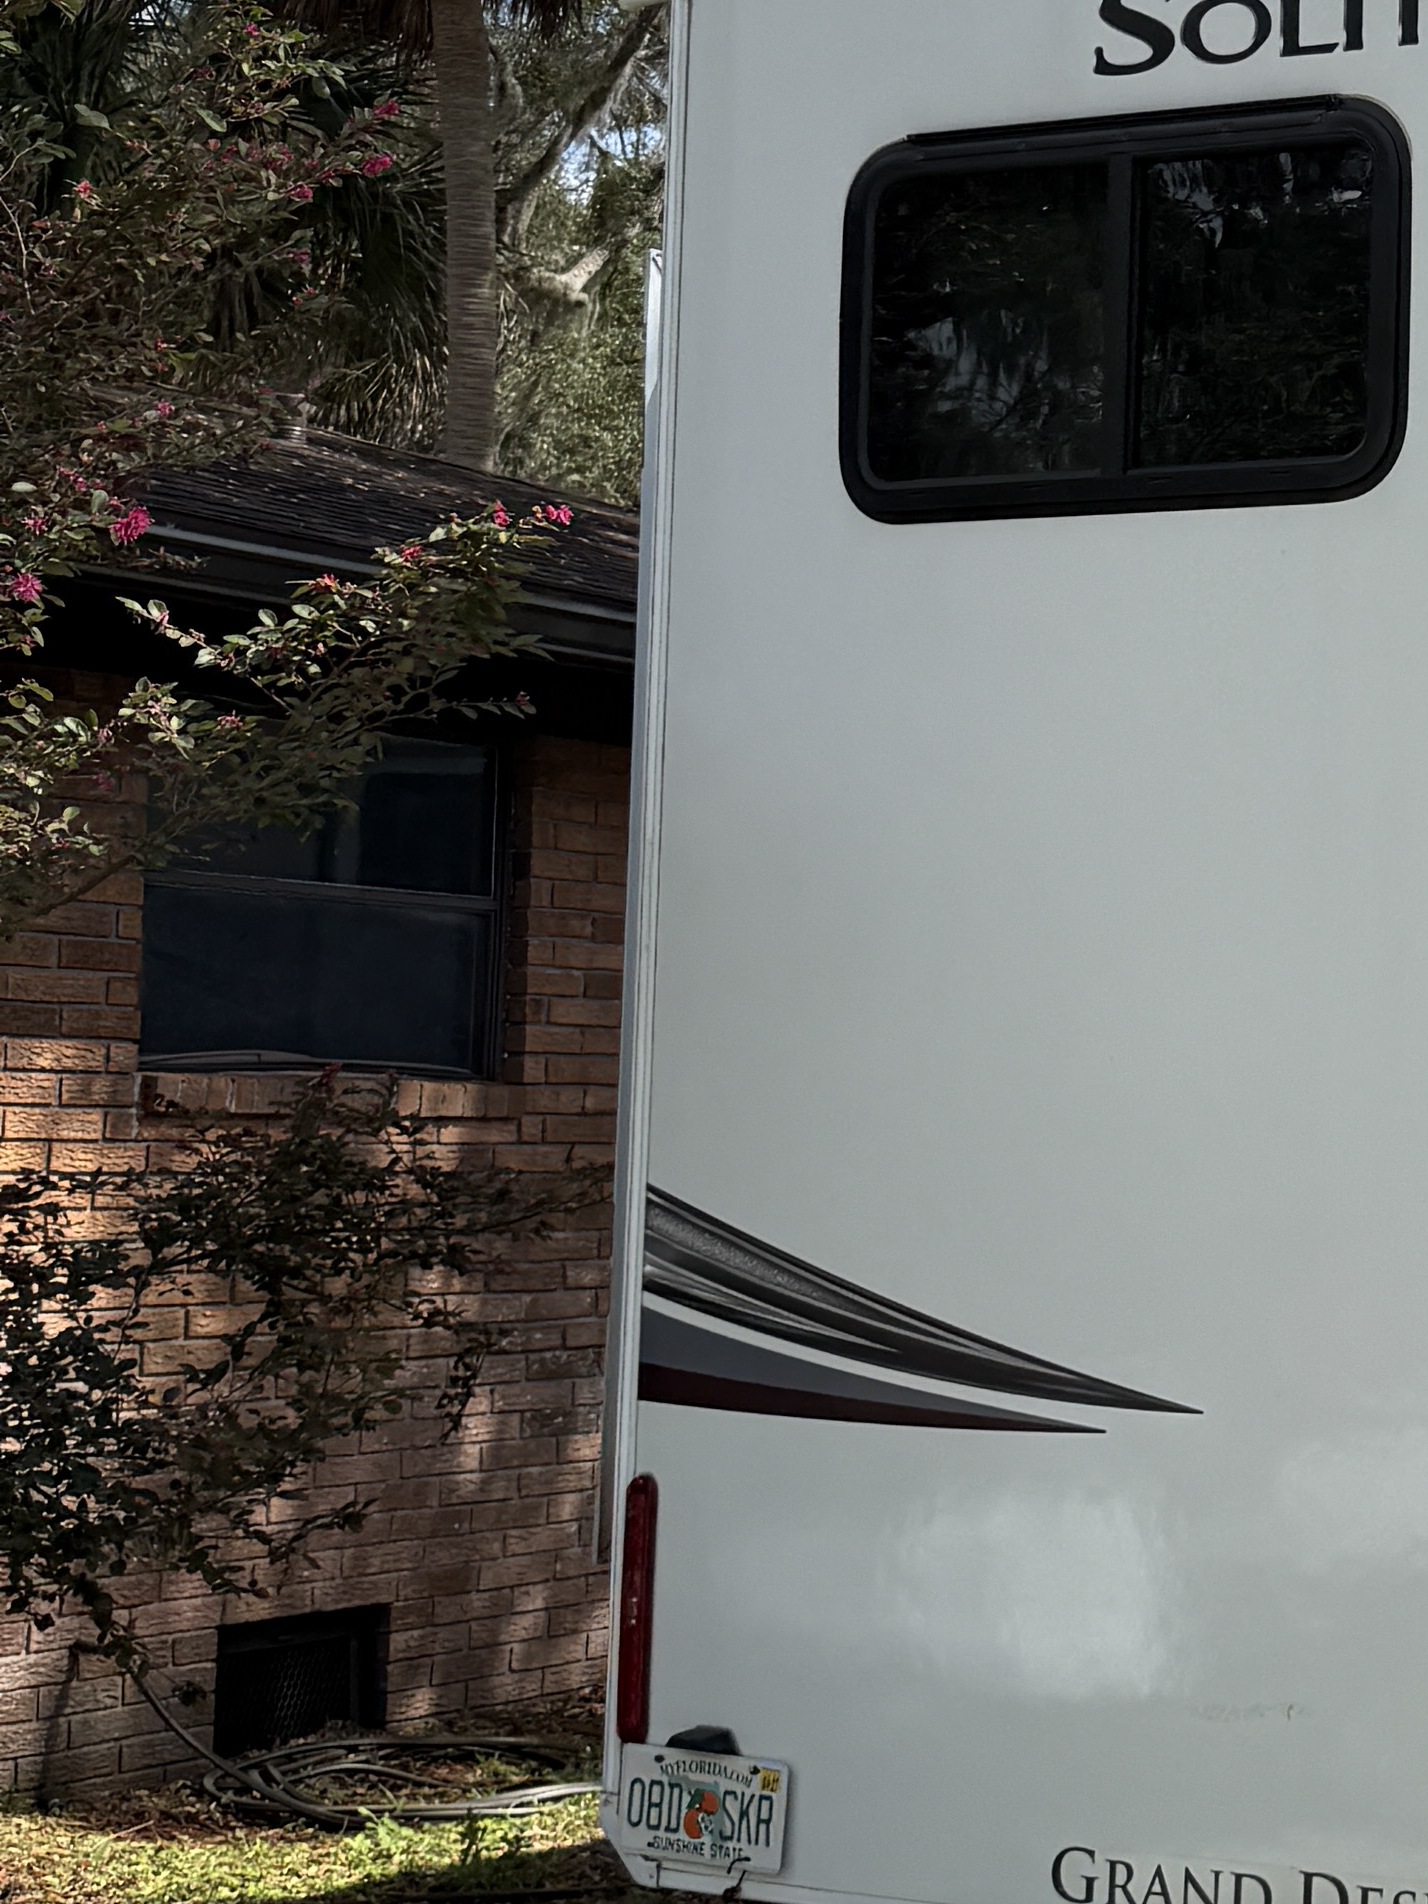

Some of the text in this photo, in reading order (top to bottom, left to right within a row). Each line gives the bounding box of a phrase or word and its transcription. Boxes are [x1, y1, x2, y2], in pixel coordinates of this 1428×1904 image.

[719, 1790, 774, 1848] SKR
[652, 1835, 744, 1860] SUNSHINE STATE
